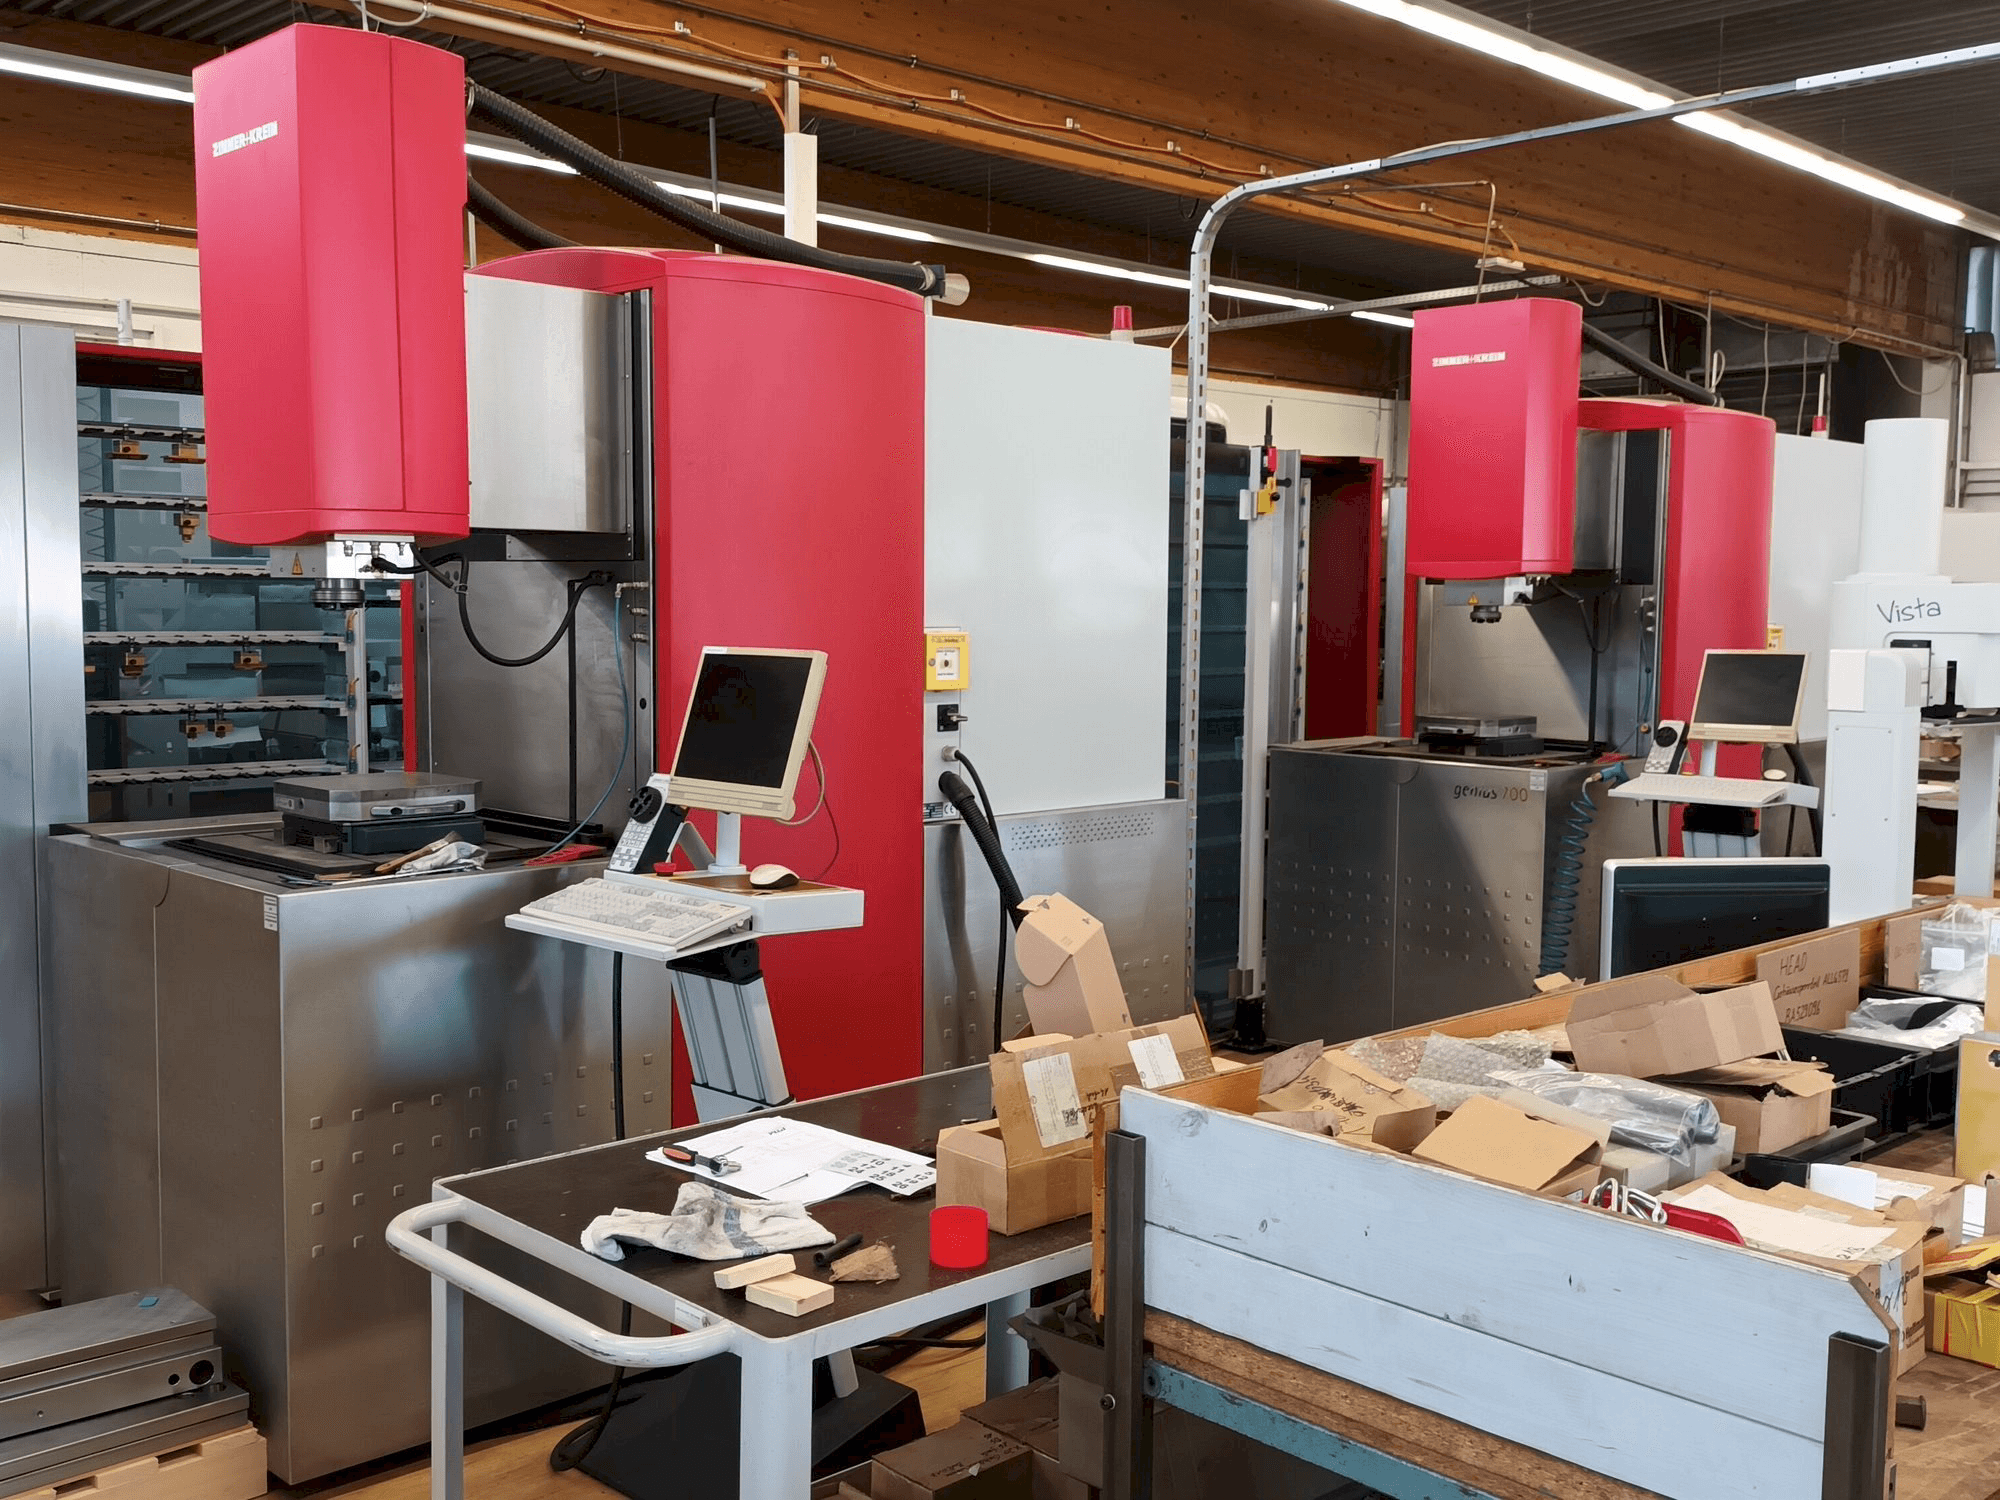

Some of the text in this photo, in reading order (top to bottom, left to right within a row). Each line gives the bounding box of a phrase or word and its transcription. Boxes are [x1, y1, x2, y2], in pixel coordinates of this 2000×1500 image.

[1876, 597, 1942, 624] Vista
[1453, 784, 1498, 800] genius
[1779, 951, 1808, 977] HEAD
